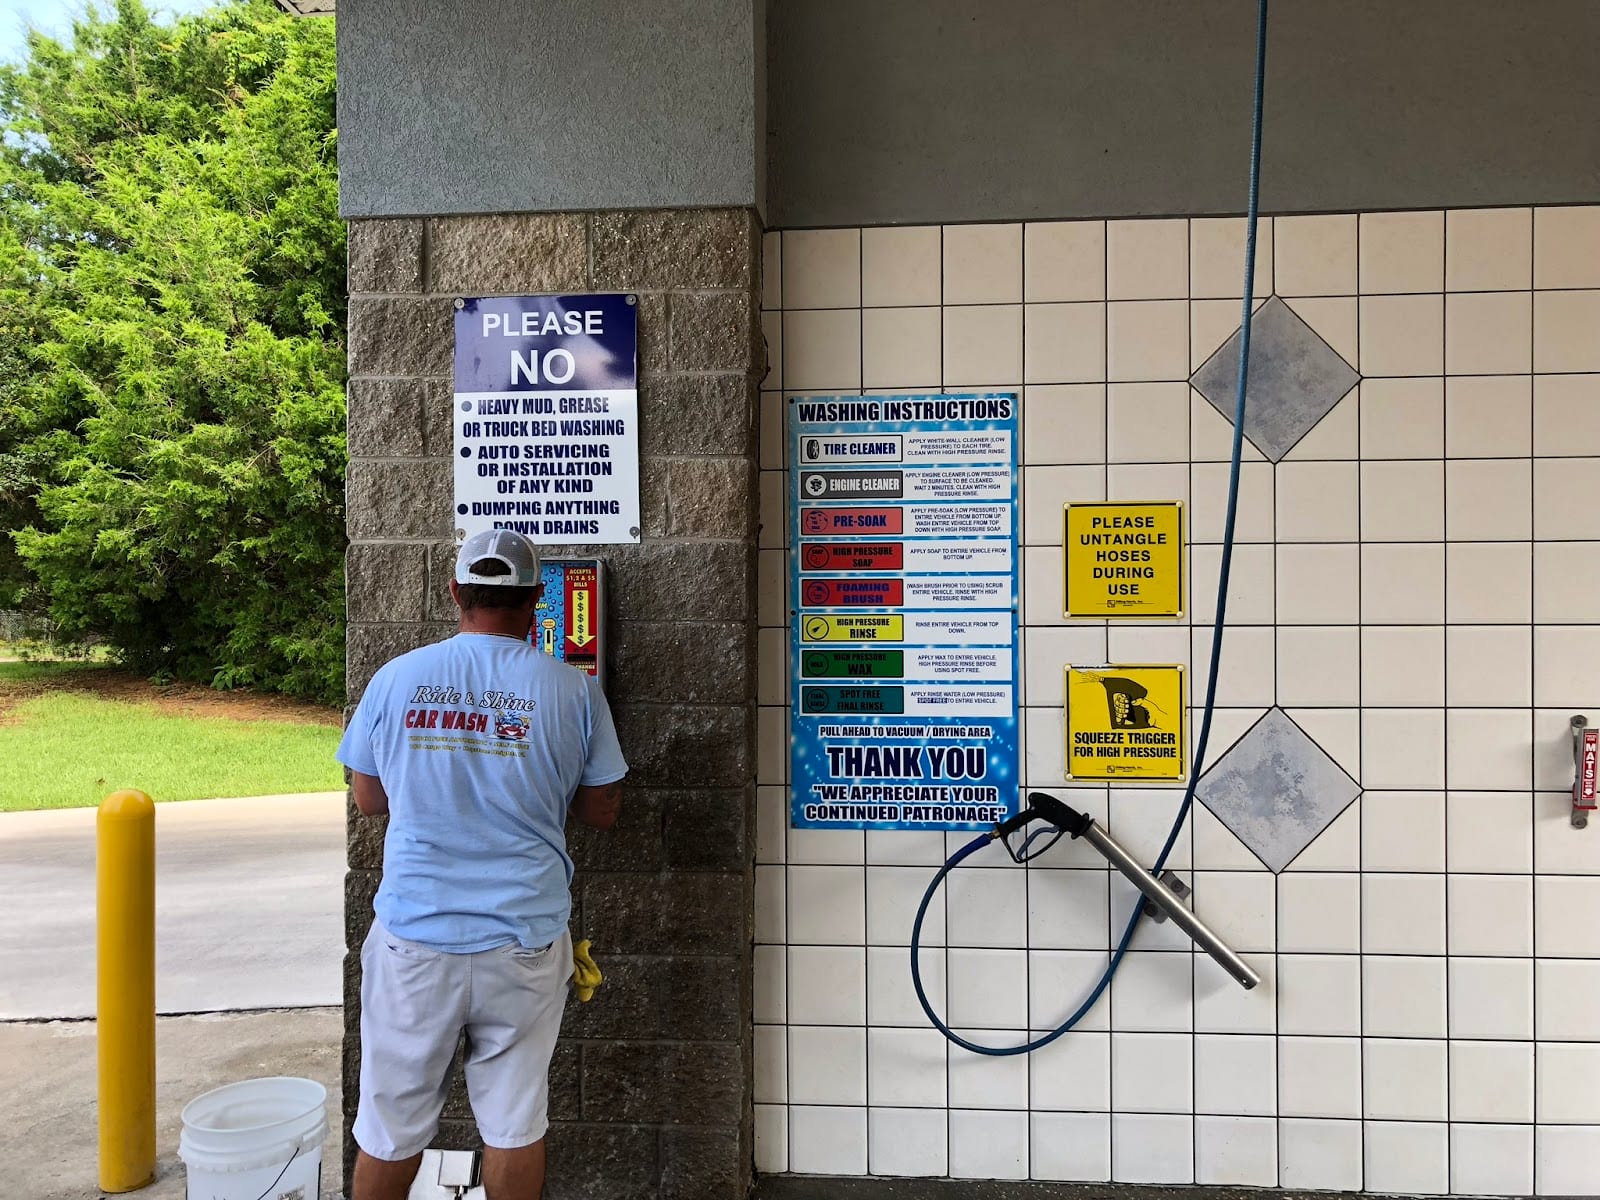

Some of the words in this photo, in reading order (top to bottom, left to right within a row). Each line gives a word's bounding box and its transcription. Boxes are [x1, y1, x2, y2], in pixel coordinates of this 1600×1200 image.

[483, 311, 604, 337] PLEASE
[511, 349, 575, 385] NO
[478, 399, 518, 415] HEAVY
[522, 398, 556, 415] MUD,
[559, 397, 609, 414] GREASE
[799, 403, 880, 422] WASHING
[884, 400, 1010, 421] INSTRUCTIONS
[463, 422, 480, 437] OR
[484, 421, 528, 437] TRUCK
[532, 420, 557, 436] BED
[561, 420, 624, 436] WASHING
[478, 445, 519, 459] AUTO
[524, 444, 609, 459] SERVICING
[824, 443, 848, 455] TIRE
[850, 442, 896, 455] CLEANER
[478, 463, 498, 476] OR
[504, 462, 612, 476] INSTALLATION
[497, 480, 515, 493] OF
[520, 480, 550, 493] ANY
[555, 479, 592, 492] KIND
[830, 479, 860, 491] ENGINE
[862, 478, 899, 491] CLEANER
[472, 502, 541, 515] DUMPING
[546, 500, 619, 514] ANYTHING
[544, 520, 599, 534] DRAINS
[834, 515, 886, 527] PRE-SOAK
[1092, 517, 1154, 528] PLEASE
[1081, 534, 1166, 545] UNTANGLE
[833, 547, 851, 556] HIGH
[854, 547, 892, 555] PRESSURE
[1097, 550, 1150, 562] HOSES
[853, 559, 873, 567] SOAP
[1093, 567, 1154, 578] DURING
[837, 583, 889, 592] FOAMING
[1108, 584, 1139, 595] USE
[843, 595, 883, 604] BRUSH
[850, 629, 876, 638] RINSE
[848, 664, 872, 675] WAX
[411, 686, 461, 703] Ride
[466, 692, 475, 705] &
[479, 691, 536, 711] Shine
[840, 690, 860, 698] SPOT
[863, 690, 880, 698] FREE
[861, 702, 884, 710] RINSE
[405, 710, 438, 728] CAR
[442, 711, 488, 732] WASH
[820, 727, 840, 736] PULL
[842, 727, 870, 736] AHEAD
[873, 727, 883, 736] TO
[886, 727, 924, 737] VACUUM
[926, 727, 930, 737] /
[933, 727, 966, 737] DRYING
[968, 727, 990, 737] AREA
[1075, 732, 1124, 744] SQUEEZE
[1128, 732, 1175, 744] TRIGGER
[1074, 747, 1093, 757] FOR
[1097, 747, 1120, 757] HIGH
[1124, 747, 1176, 758] PRESSURE
[827, 747, 922, 777] THANK
[928, 748, 985, 778] YOU
[1586, 744, 1595, 778] MATS
[813, 786, 847, 800] "WE
[851, 786, 948, 801] APPRECIATE
[952, 787, 997, 801] YOUR
[806, 806, 898, 820] CONTINUED
[903, 806, 1006, 822] PATRONAGE"
